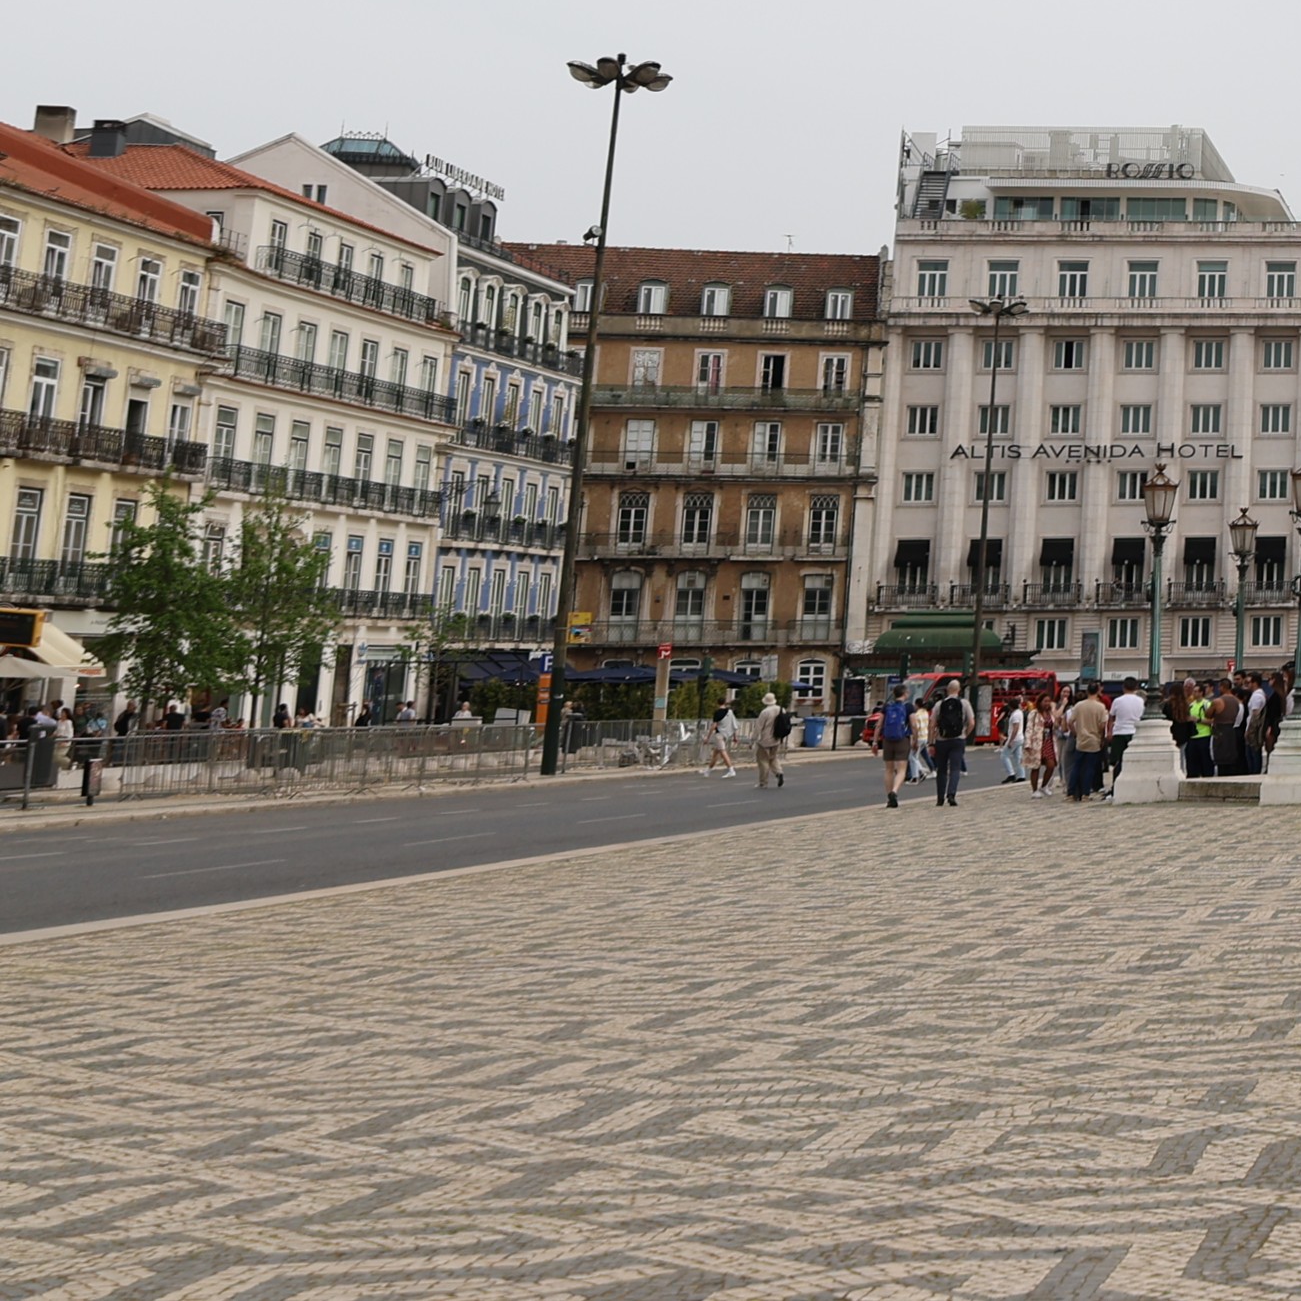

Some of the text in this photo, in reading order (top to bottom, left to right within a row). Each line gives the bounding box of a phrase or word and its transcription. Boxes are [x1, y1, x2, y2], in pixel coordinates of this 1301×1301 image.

[950, 442, 1244, 460] ALTIS AVENIDA HOTEL
